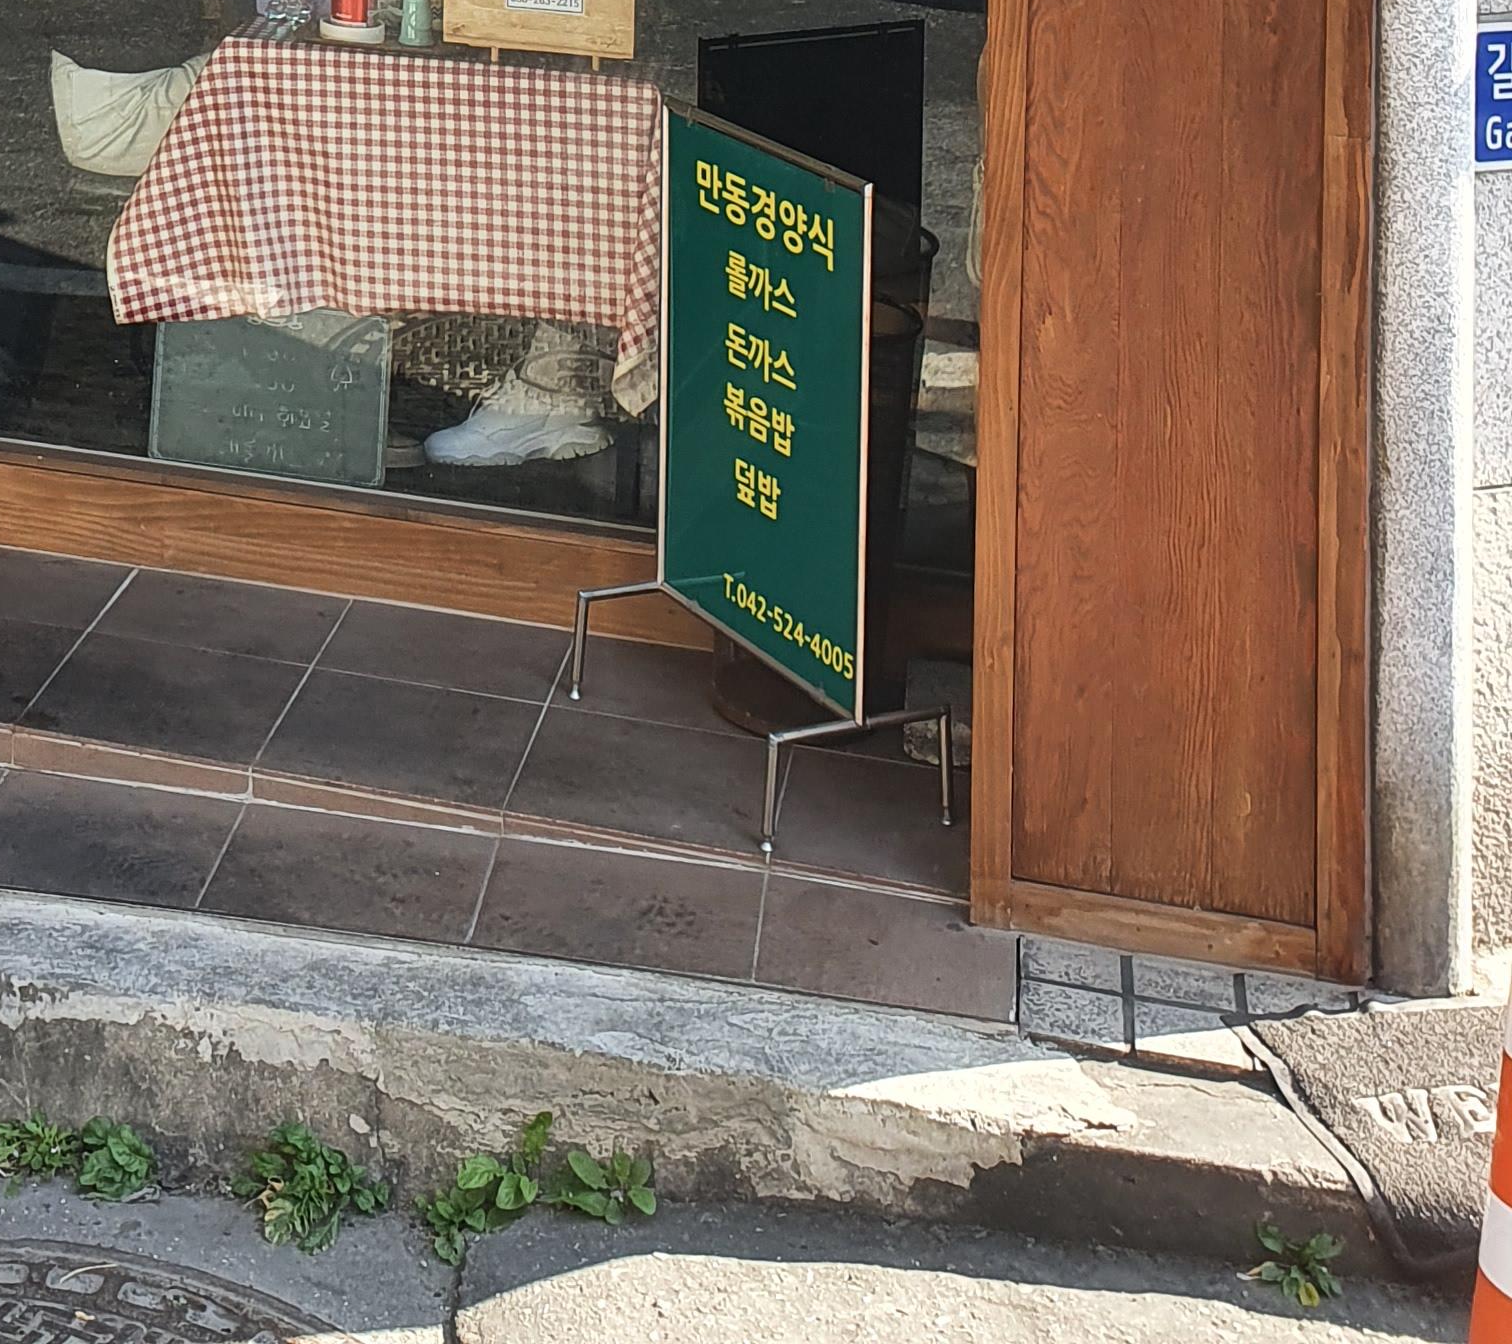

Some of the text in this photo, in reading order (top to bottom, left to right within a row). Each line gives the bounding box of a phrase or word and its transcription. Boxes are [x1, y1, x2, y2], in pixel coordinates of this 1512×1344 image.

[696, 160, 834, 272] 만동경양식
[725, 250, 797, 318] 롤까스
[725, 322, 797, 390] 돈까스
[724, 382, 795, 457] 볶음밥
[735, 458, 781, 520] 덮밥
[723, 573, 854, 679] T.042-524-4005
